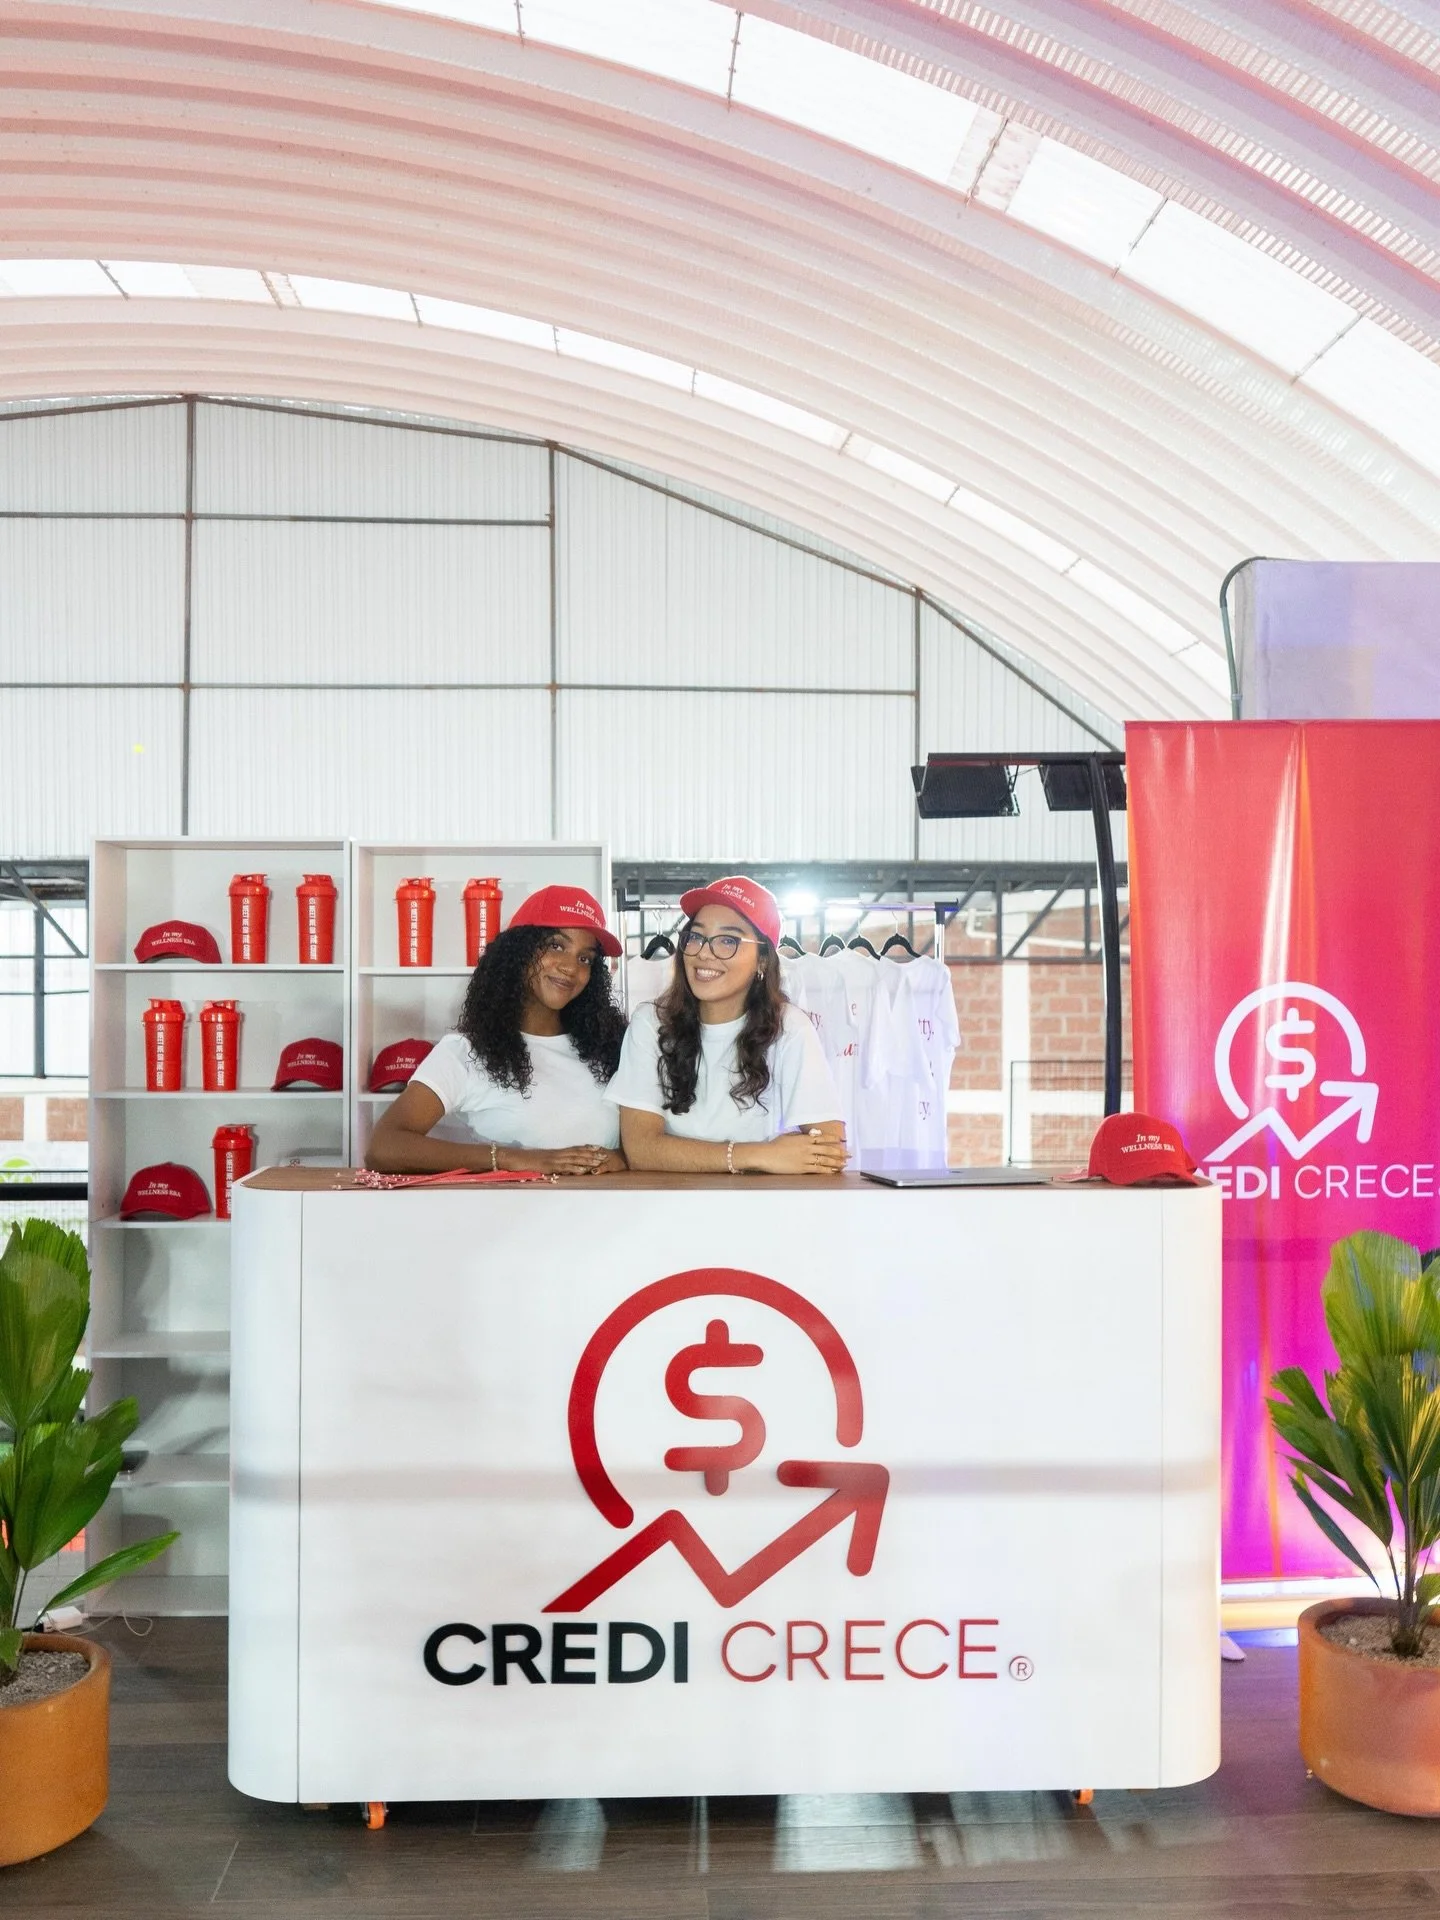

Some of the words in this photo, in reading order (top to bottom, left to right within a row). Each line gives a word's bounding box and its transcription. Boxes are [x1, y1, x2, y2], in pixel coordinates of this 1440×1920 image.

[560, 906, 594, 921] WELLNESS
[576, 900, 584, 908] In
[586, 905, 595, 914] my
[1136, 1134, 1146, 1142] In
[1148, 1135, 1160, 1144] my
[1121, 1144, 1162, 1154] WELLNESS
[1163, 1144, 1176, 1152] ERA
[1198, 1166, 1280, 1200] EDI
[1294, 1164, 1434, 1199] CRECE
[423, 1621, 688, 1686] CREDI
[720, 1618, 999, 1683] CRECE
